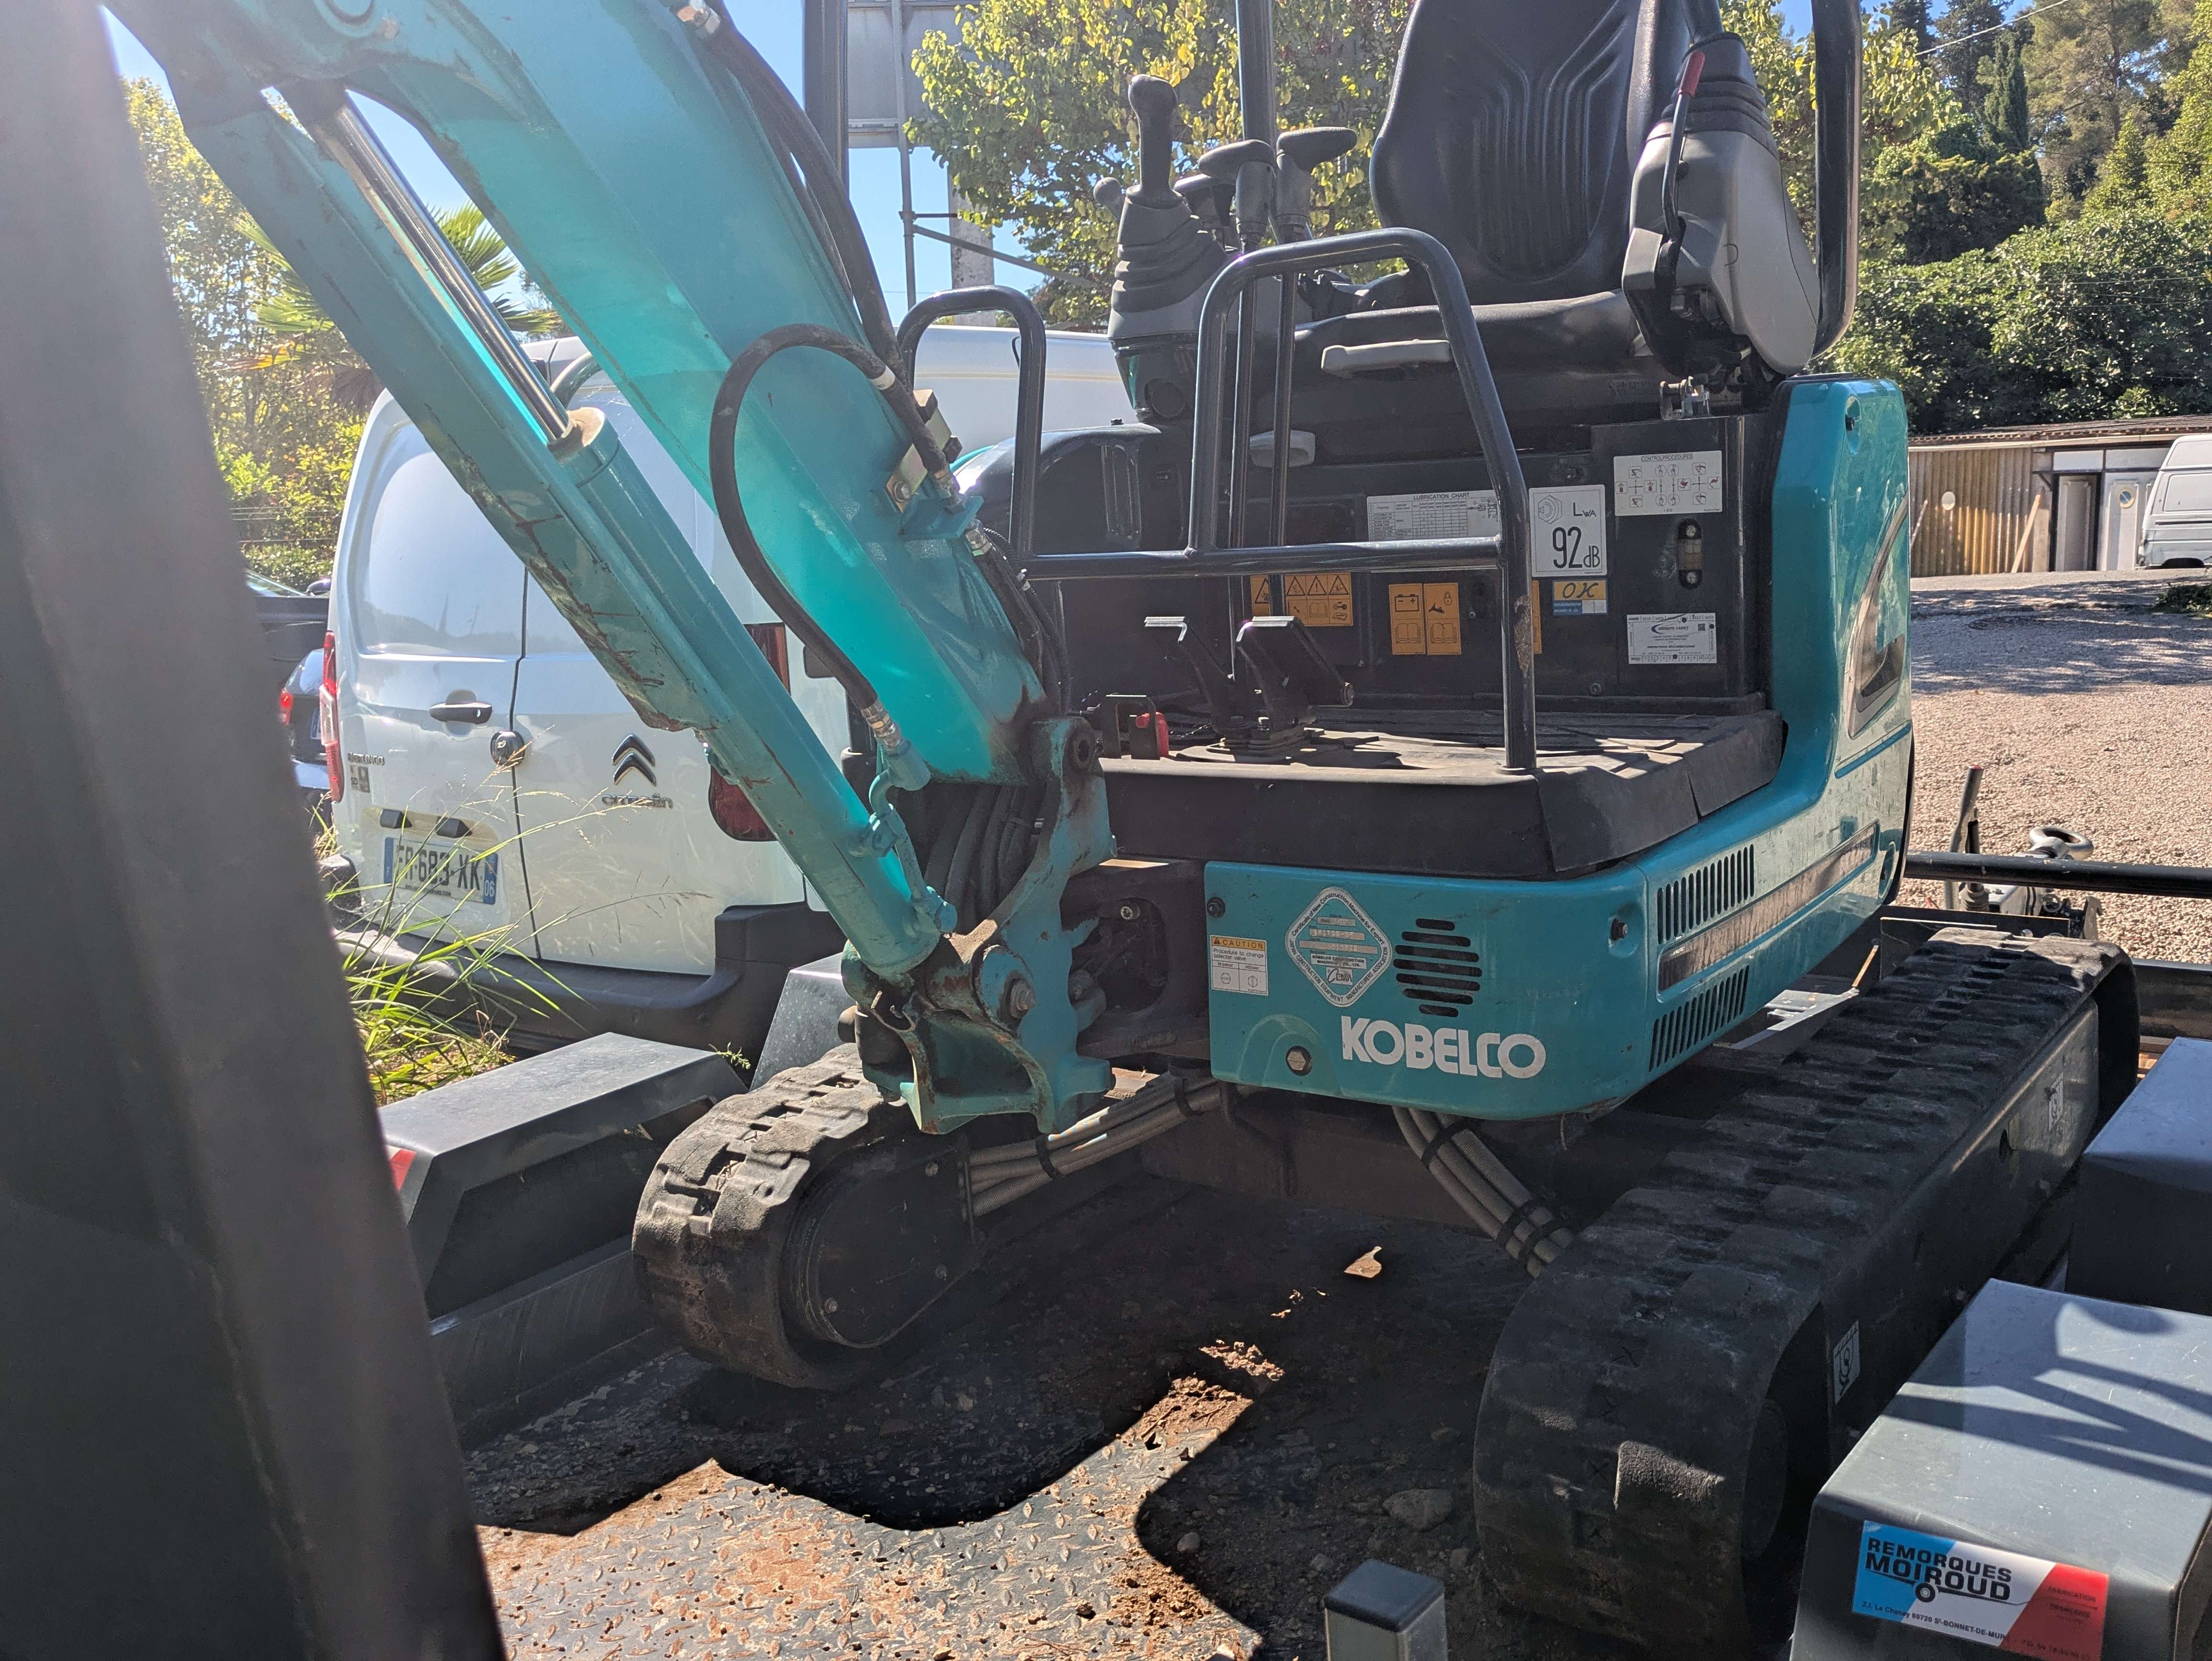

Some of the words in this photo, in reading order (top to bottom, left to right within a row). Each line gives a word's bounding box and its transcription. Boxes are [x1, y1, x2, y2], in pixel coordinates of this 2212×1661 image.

[1552, 526, 1582, 568] 92
[1583, 545, 1601, 568] dB
[1562, 582, 1599, 598] OK
[485, 880, 495, 897] 06
[1292, 914, 1311, 936] Certificate
[1312, 903, 1322, 914] New
[1320, 893, 1349, 904] Construction
[1348, 902, 1366, 923] Machine
[1370, 927, 1385, 946] Export
[1222, 939, 1263, 950] CAUTION
[1289, 939, 1297, 955] JAPAN
[1296, 954, 1321, 984] CONSTRUCTION
[1320, 983, 1344, 1002] EQUIPMENT
[1346, 971, 1374, 1001] MANUFACTURERS
[1372, 947, 1388, 974] ASSOCIATION
[1341, 1015, 1546, 1078] KOBELCO
[1865, 1551, 2011, 1601] MOIROUD
[1868, 1537, 2012, 1583] REMORQUES
[1885, 1606, 1911, 1619] Chanay
[1911, 1613, 1933, 1623] 69720
